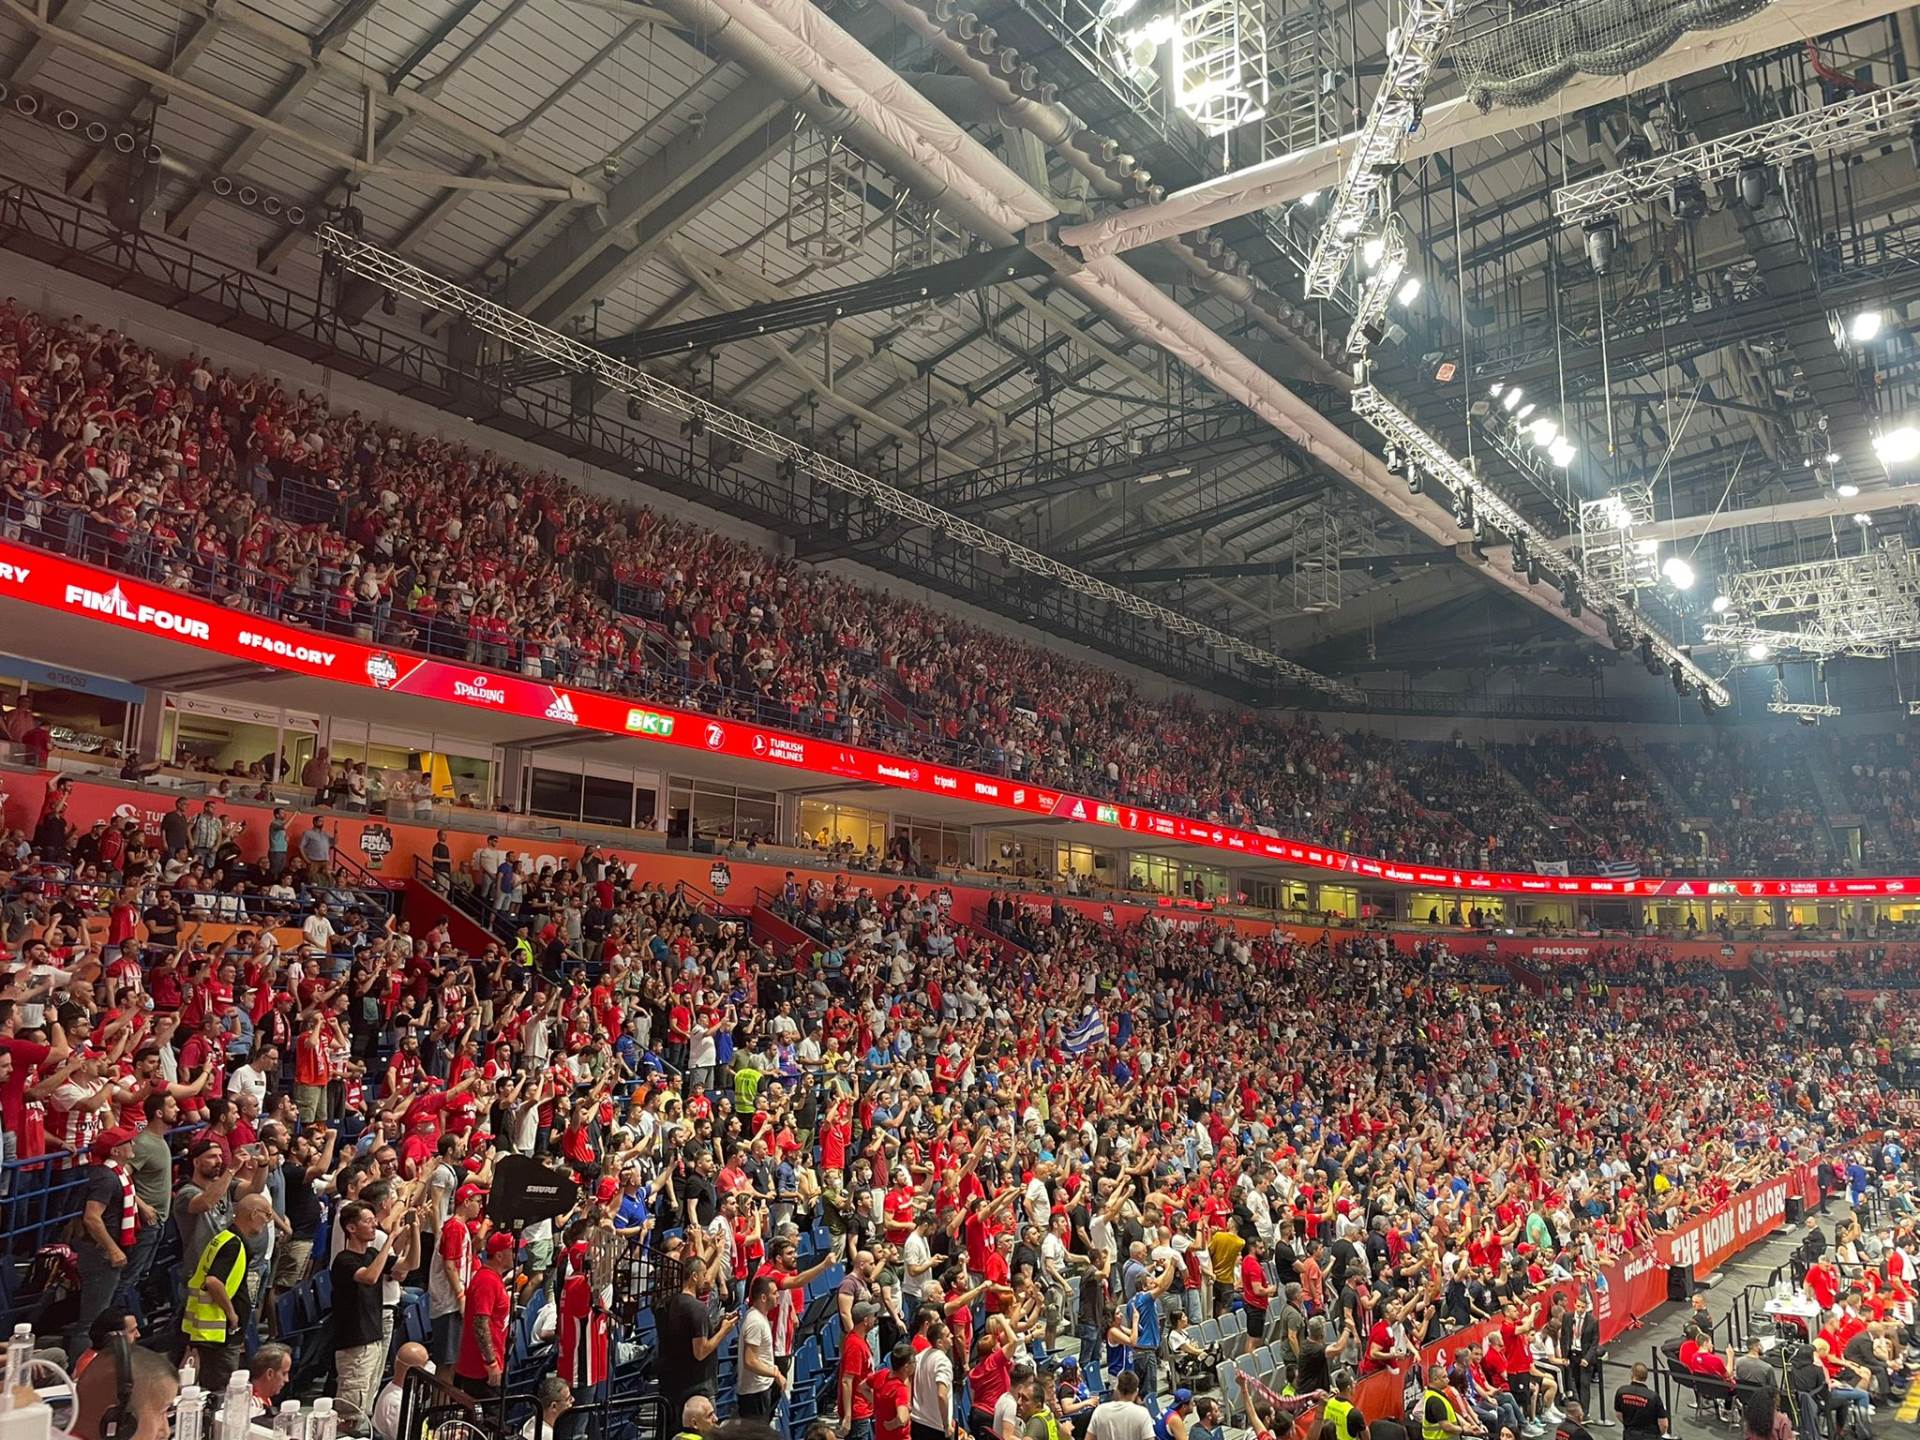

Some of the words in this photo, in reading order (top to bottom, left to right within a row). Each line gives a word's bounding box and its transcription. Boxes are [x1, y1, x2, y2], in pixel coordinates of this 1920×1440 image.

[138, 605, 210, 640] FOUR
[238, 631, 336, 667] #F4GLORY
[454, 681, 505, 704] SPALDING
[545, 708, 578, 722] adidas
[628, 710, 673, 734] BKT
[768, 750, 804, 763] AIRLINES
[770, 738, 804, 753] TURKISH
[526, 1185, 560, 1194] SHURE
[1671, 1228, 1701, 1265] THE
[1702, 1207, 1736, 1258] HOME
[1738, 1199, 1753, 1235] OF
[1756, 1182, 1788, 1225] GLORY
